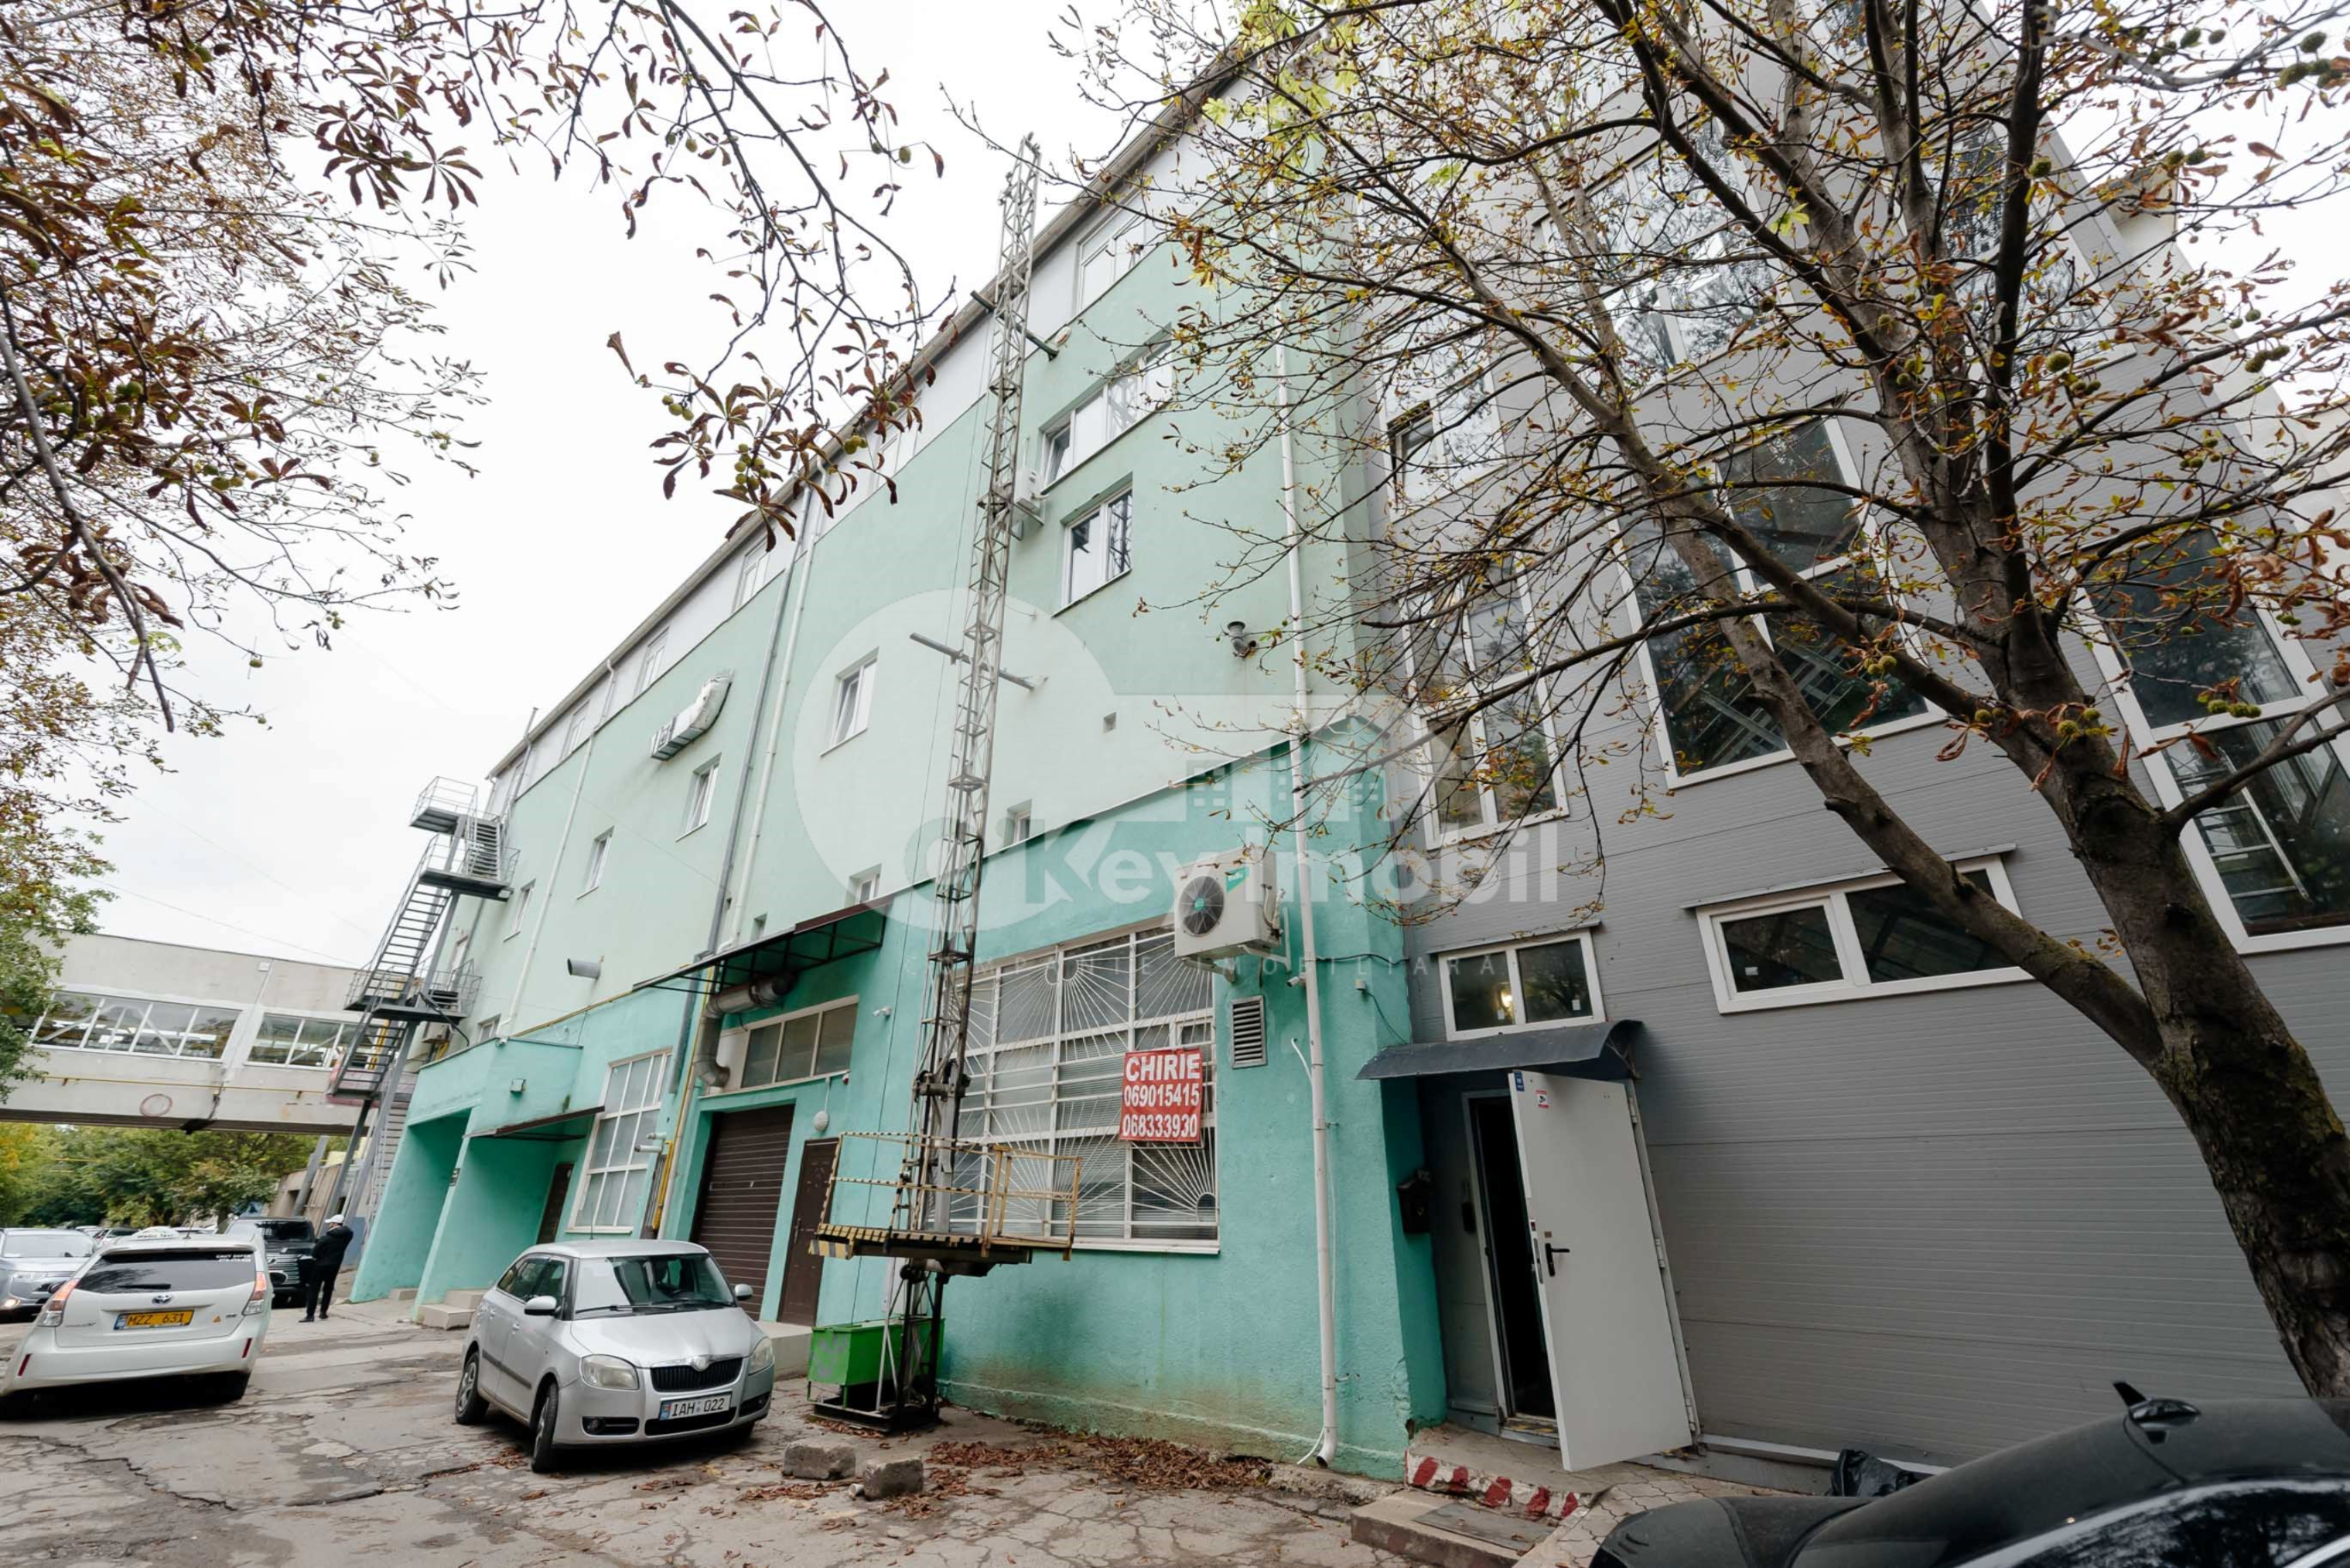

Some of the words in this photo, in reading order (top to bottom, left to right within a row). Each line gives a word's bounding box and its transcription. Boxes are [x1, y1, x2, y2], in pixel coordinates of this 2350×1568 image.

[1125, 1053, 1201, 1081] CHIRIE
[1123, 1083, 1200, 1107] 069015415
[1123, 1113, 1197, 1138] 068333930
[129, 1314, 152, 1326] MZZ
[162, 1313, 184, 1324] 631
[672, 1401, 696, 1417] IAH
[703, 1397, 725, 1413] 022
